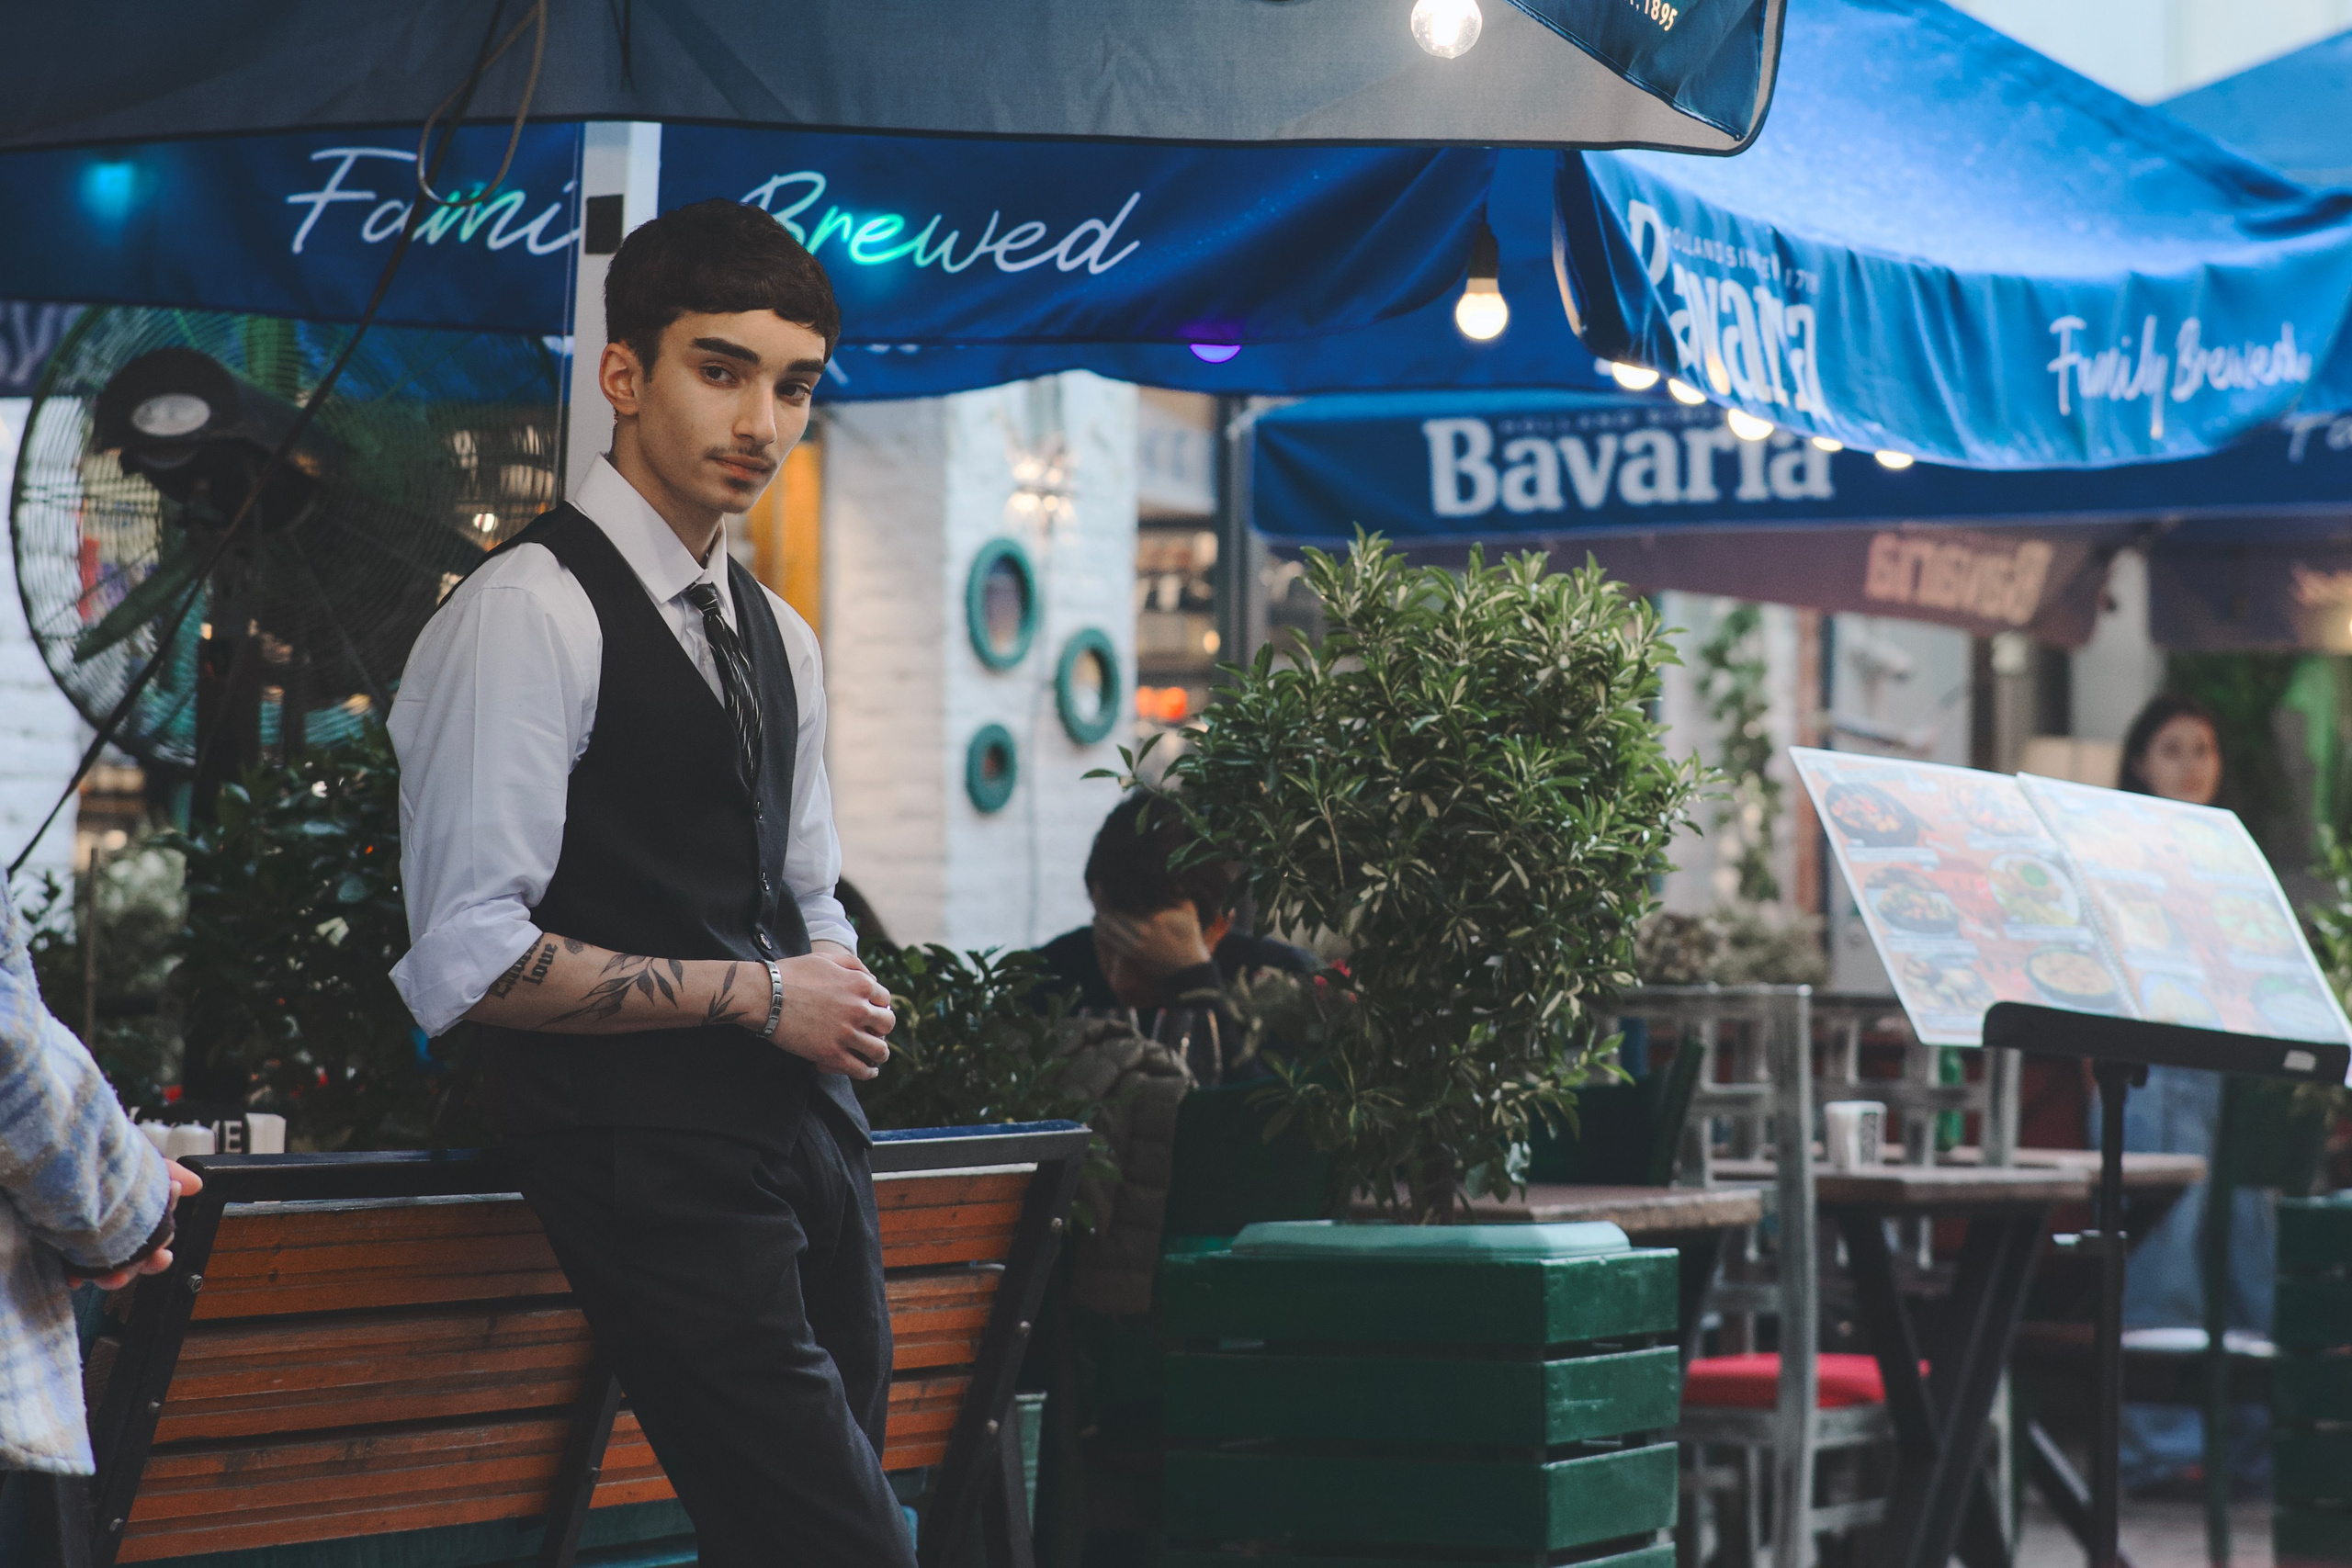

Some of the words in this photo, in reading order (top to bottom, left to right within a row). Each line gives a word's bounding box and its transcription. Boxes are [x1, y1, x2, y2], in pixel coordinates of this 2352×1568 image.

[1644, 0, 1679, 31] 1895
[286, 145, 581, 256] Fami
[739, 169, 1141, 275] Brewed
[1421, 417, 1837, 518] Bavaria
